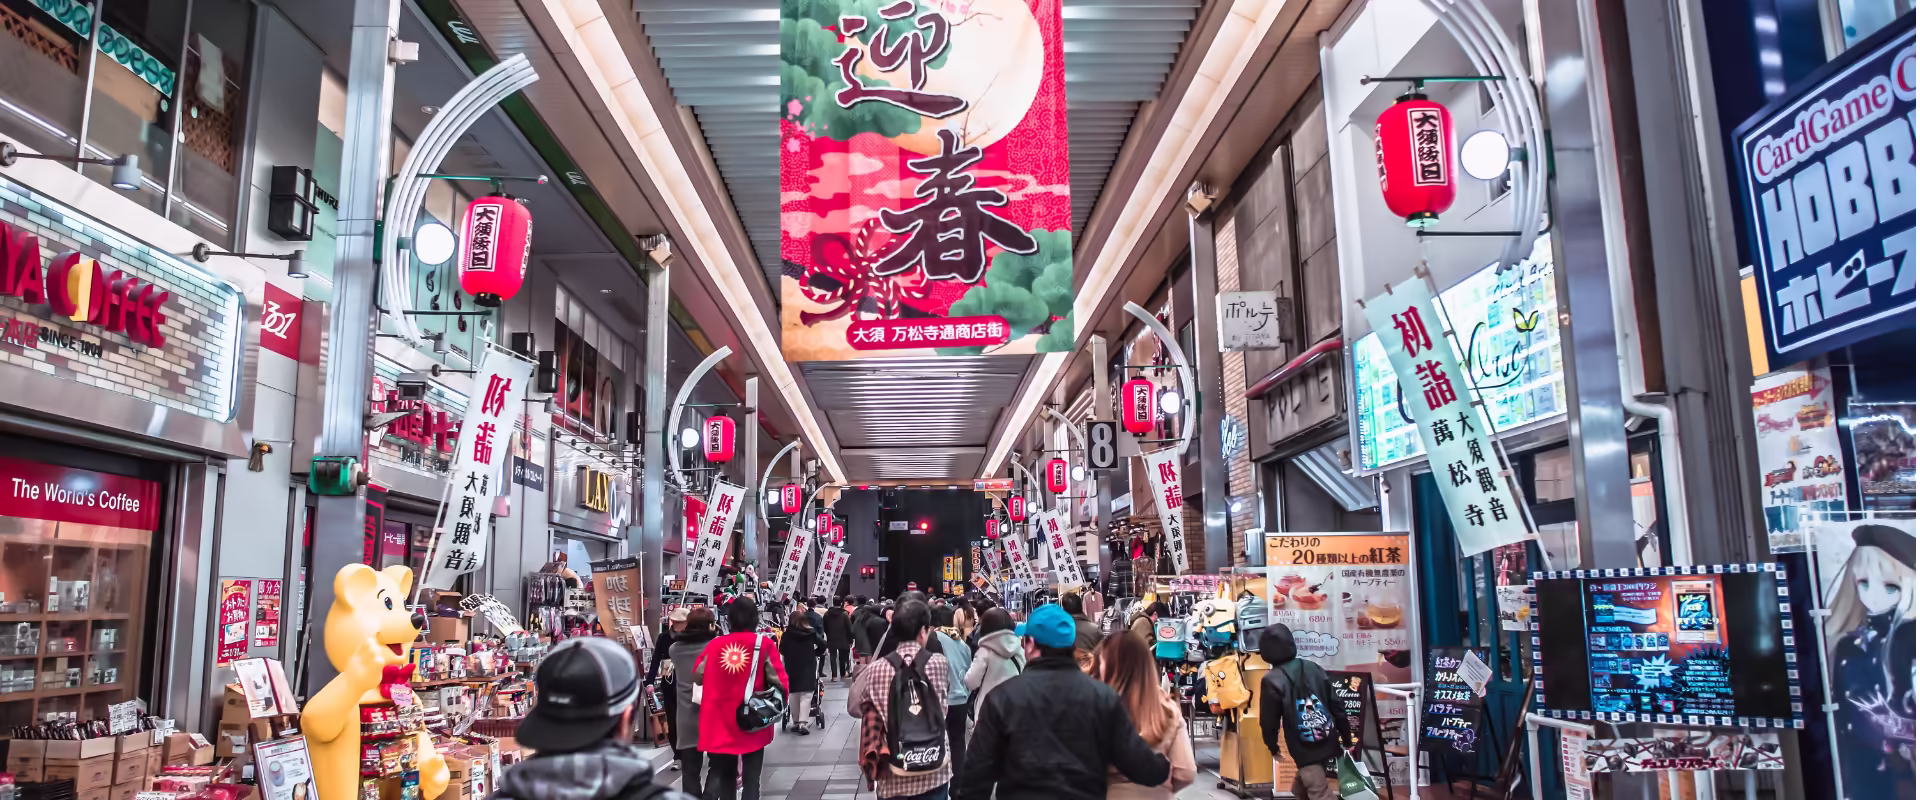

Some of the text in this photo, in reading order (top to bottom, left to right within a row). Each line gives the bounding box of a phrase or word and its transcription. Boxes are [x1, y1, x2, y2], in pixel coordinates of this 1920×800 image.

[831, 0, 1039, 283] 迎春
[1755, 82, 1888, 177] CardGame
[1225, 301, 1275, 332] ポルテ
[39, 326, 77, 351] SINCE
[853, 322, 1003, 343] 大須 万松寺通商店街
[1391, 305, 1458, 411] 初詣
[1091, 423, 1114, 468] 8
[1431, 418, 1486, 528] 萬松寺
[1456, 411, 1509, 523] 大須観音
[12, 478, 140, 512] The World's Coffee
[1047, 518, 1064, 550] 初詣
[1270, 537, 1321, 548] こだわりの
[1292, 547, 1401, 565] 20種類以上の紅茶
[1170, 578, 1214, 586] SALE
[1353, 579, 1397, 587] ハーブティー
[1434, 690, 1471, 701] オススメ紅茶
